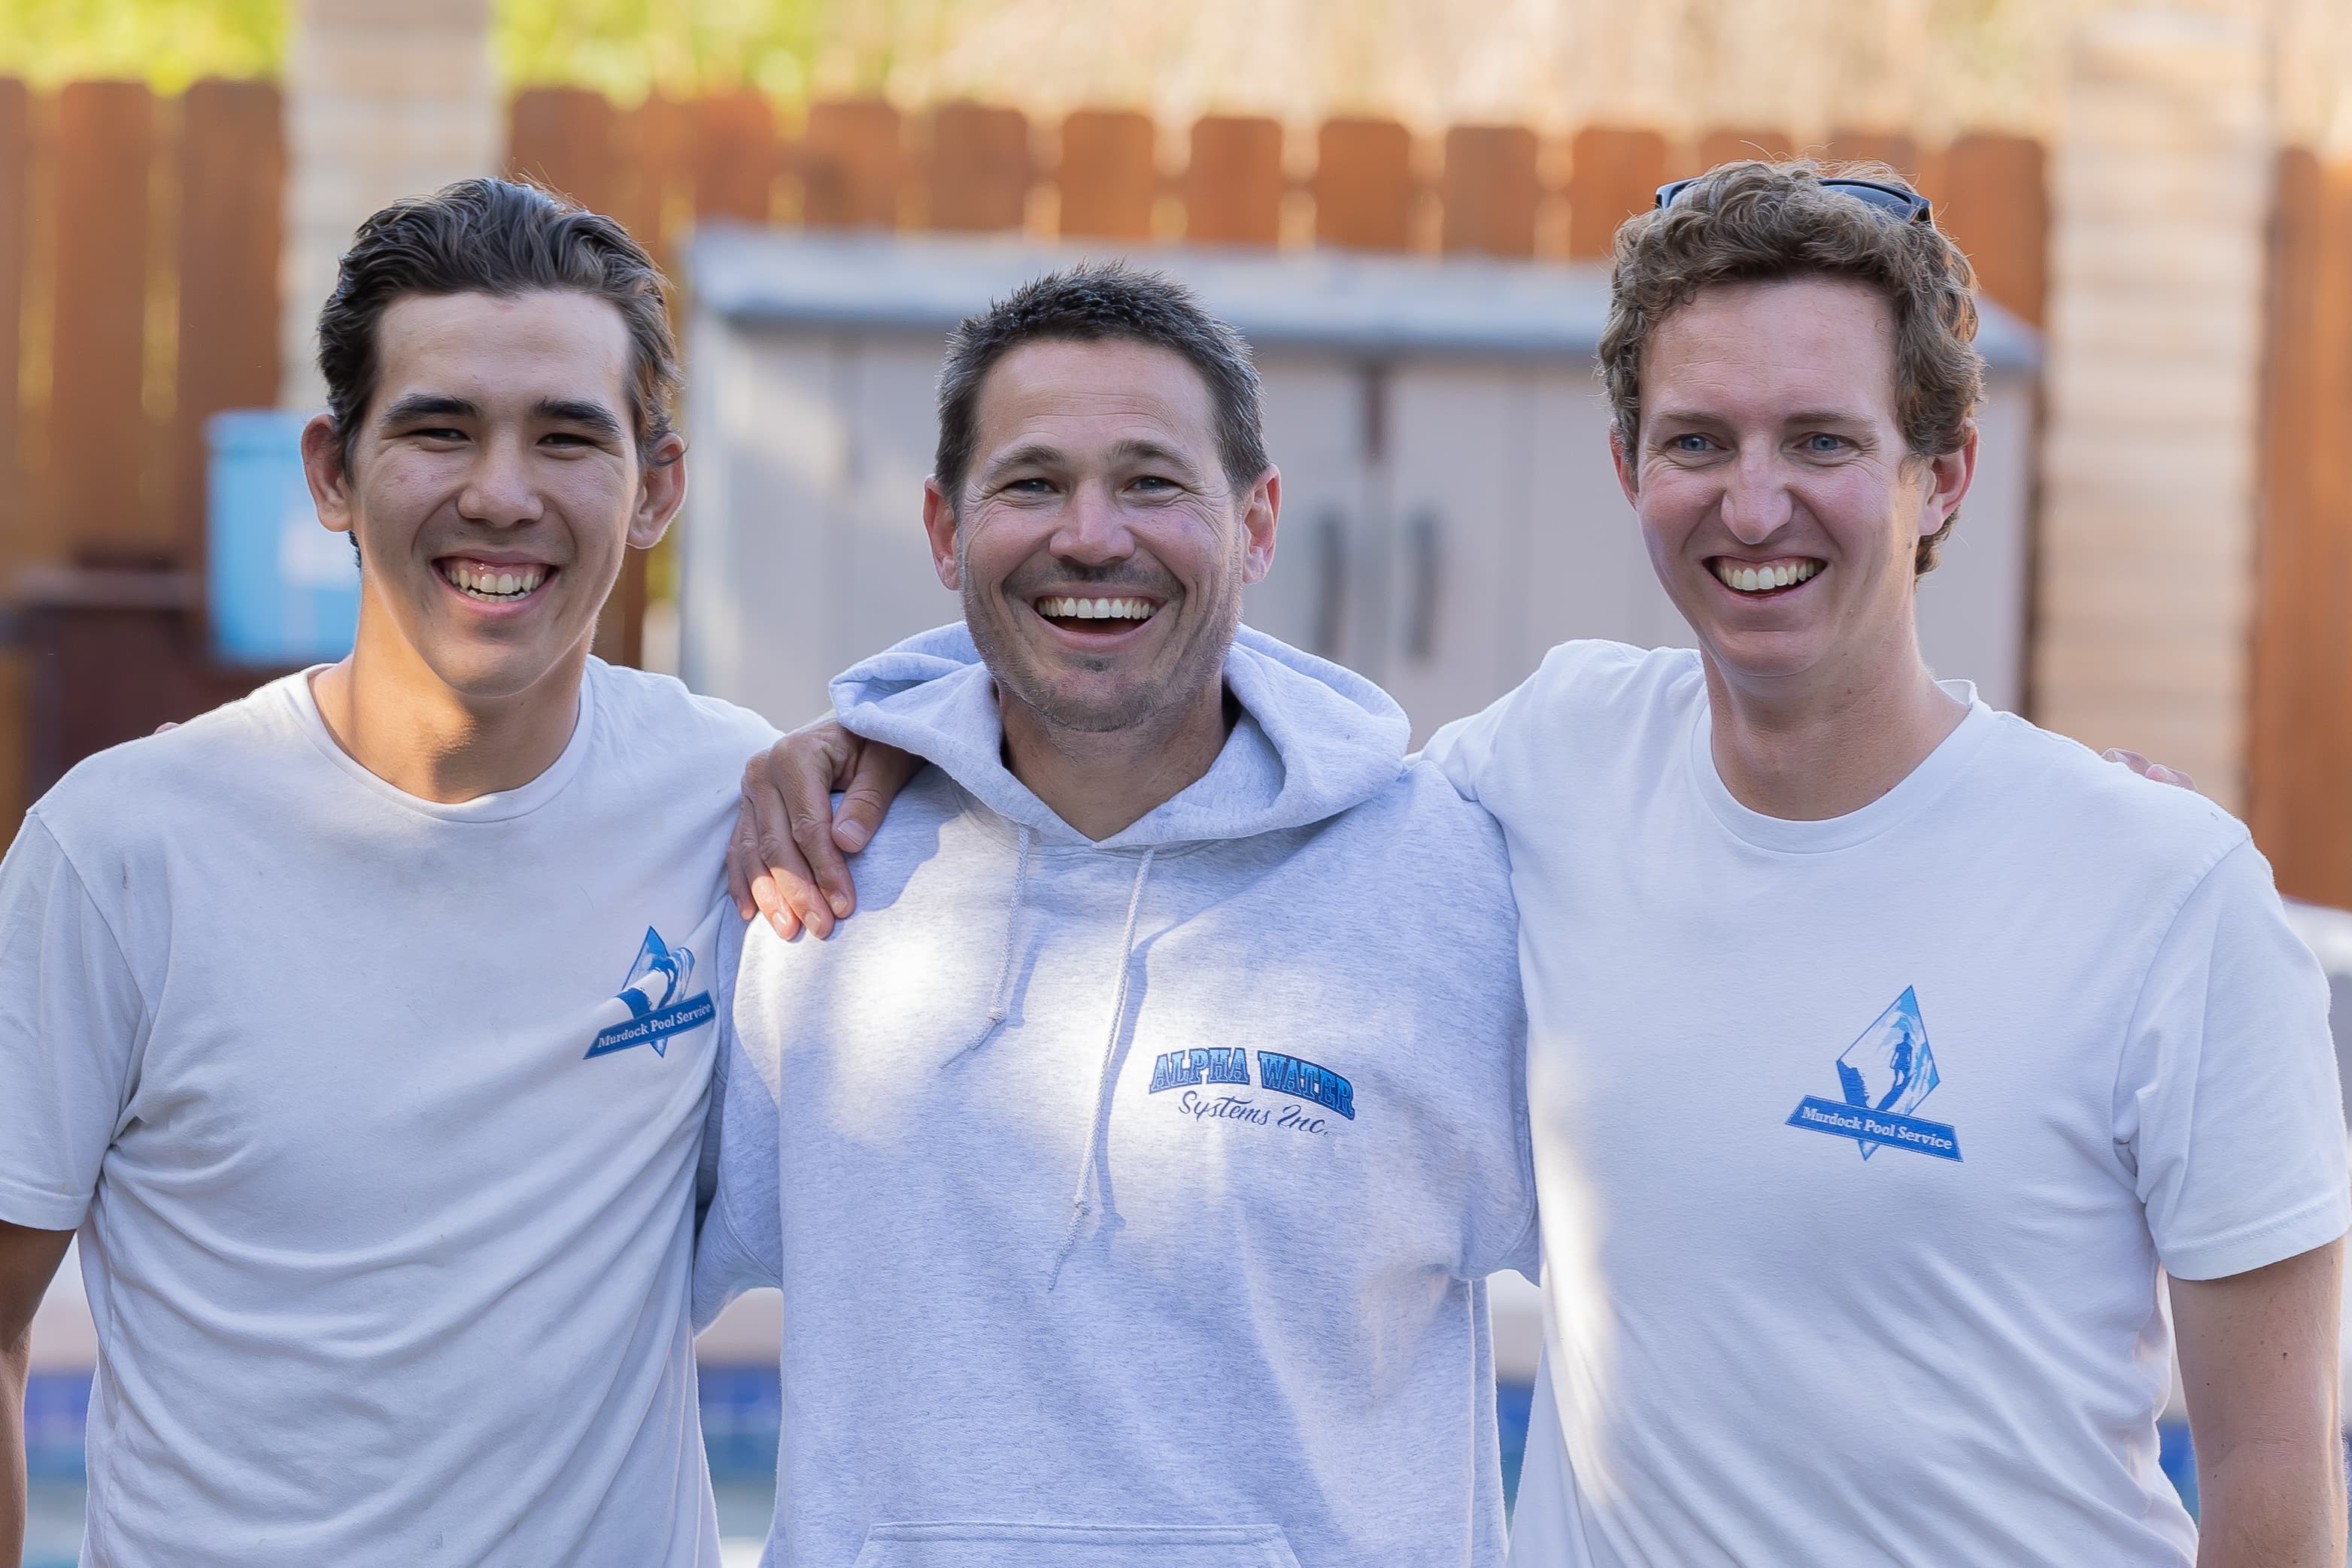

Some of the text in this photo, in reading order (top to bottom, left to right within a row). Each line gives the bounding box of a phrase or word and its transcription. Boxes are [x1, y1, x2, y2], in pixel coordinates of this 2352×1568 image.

[597, 1003, 712, 1048] Murdock Pool Service
[1149, 1048, 1355, 1121] ALPHA WATER
[1179, 1090, 1328, 1135] Systems Inc.
[1801, 1106, 1953, 1150] Murdock Pool Service
